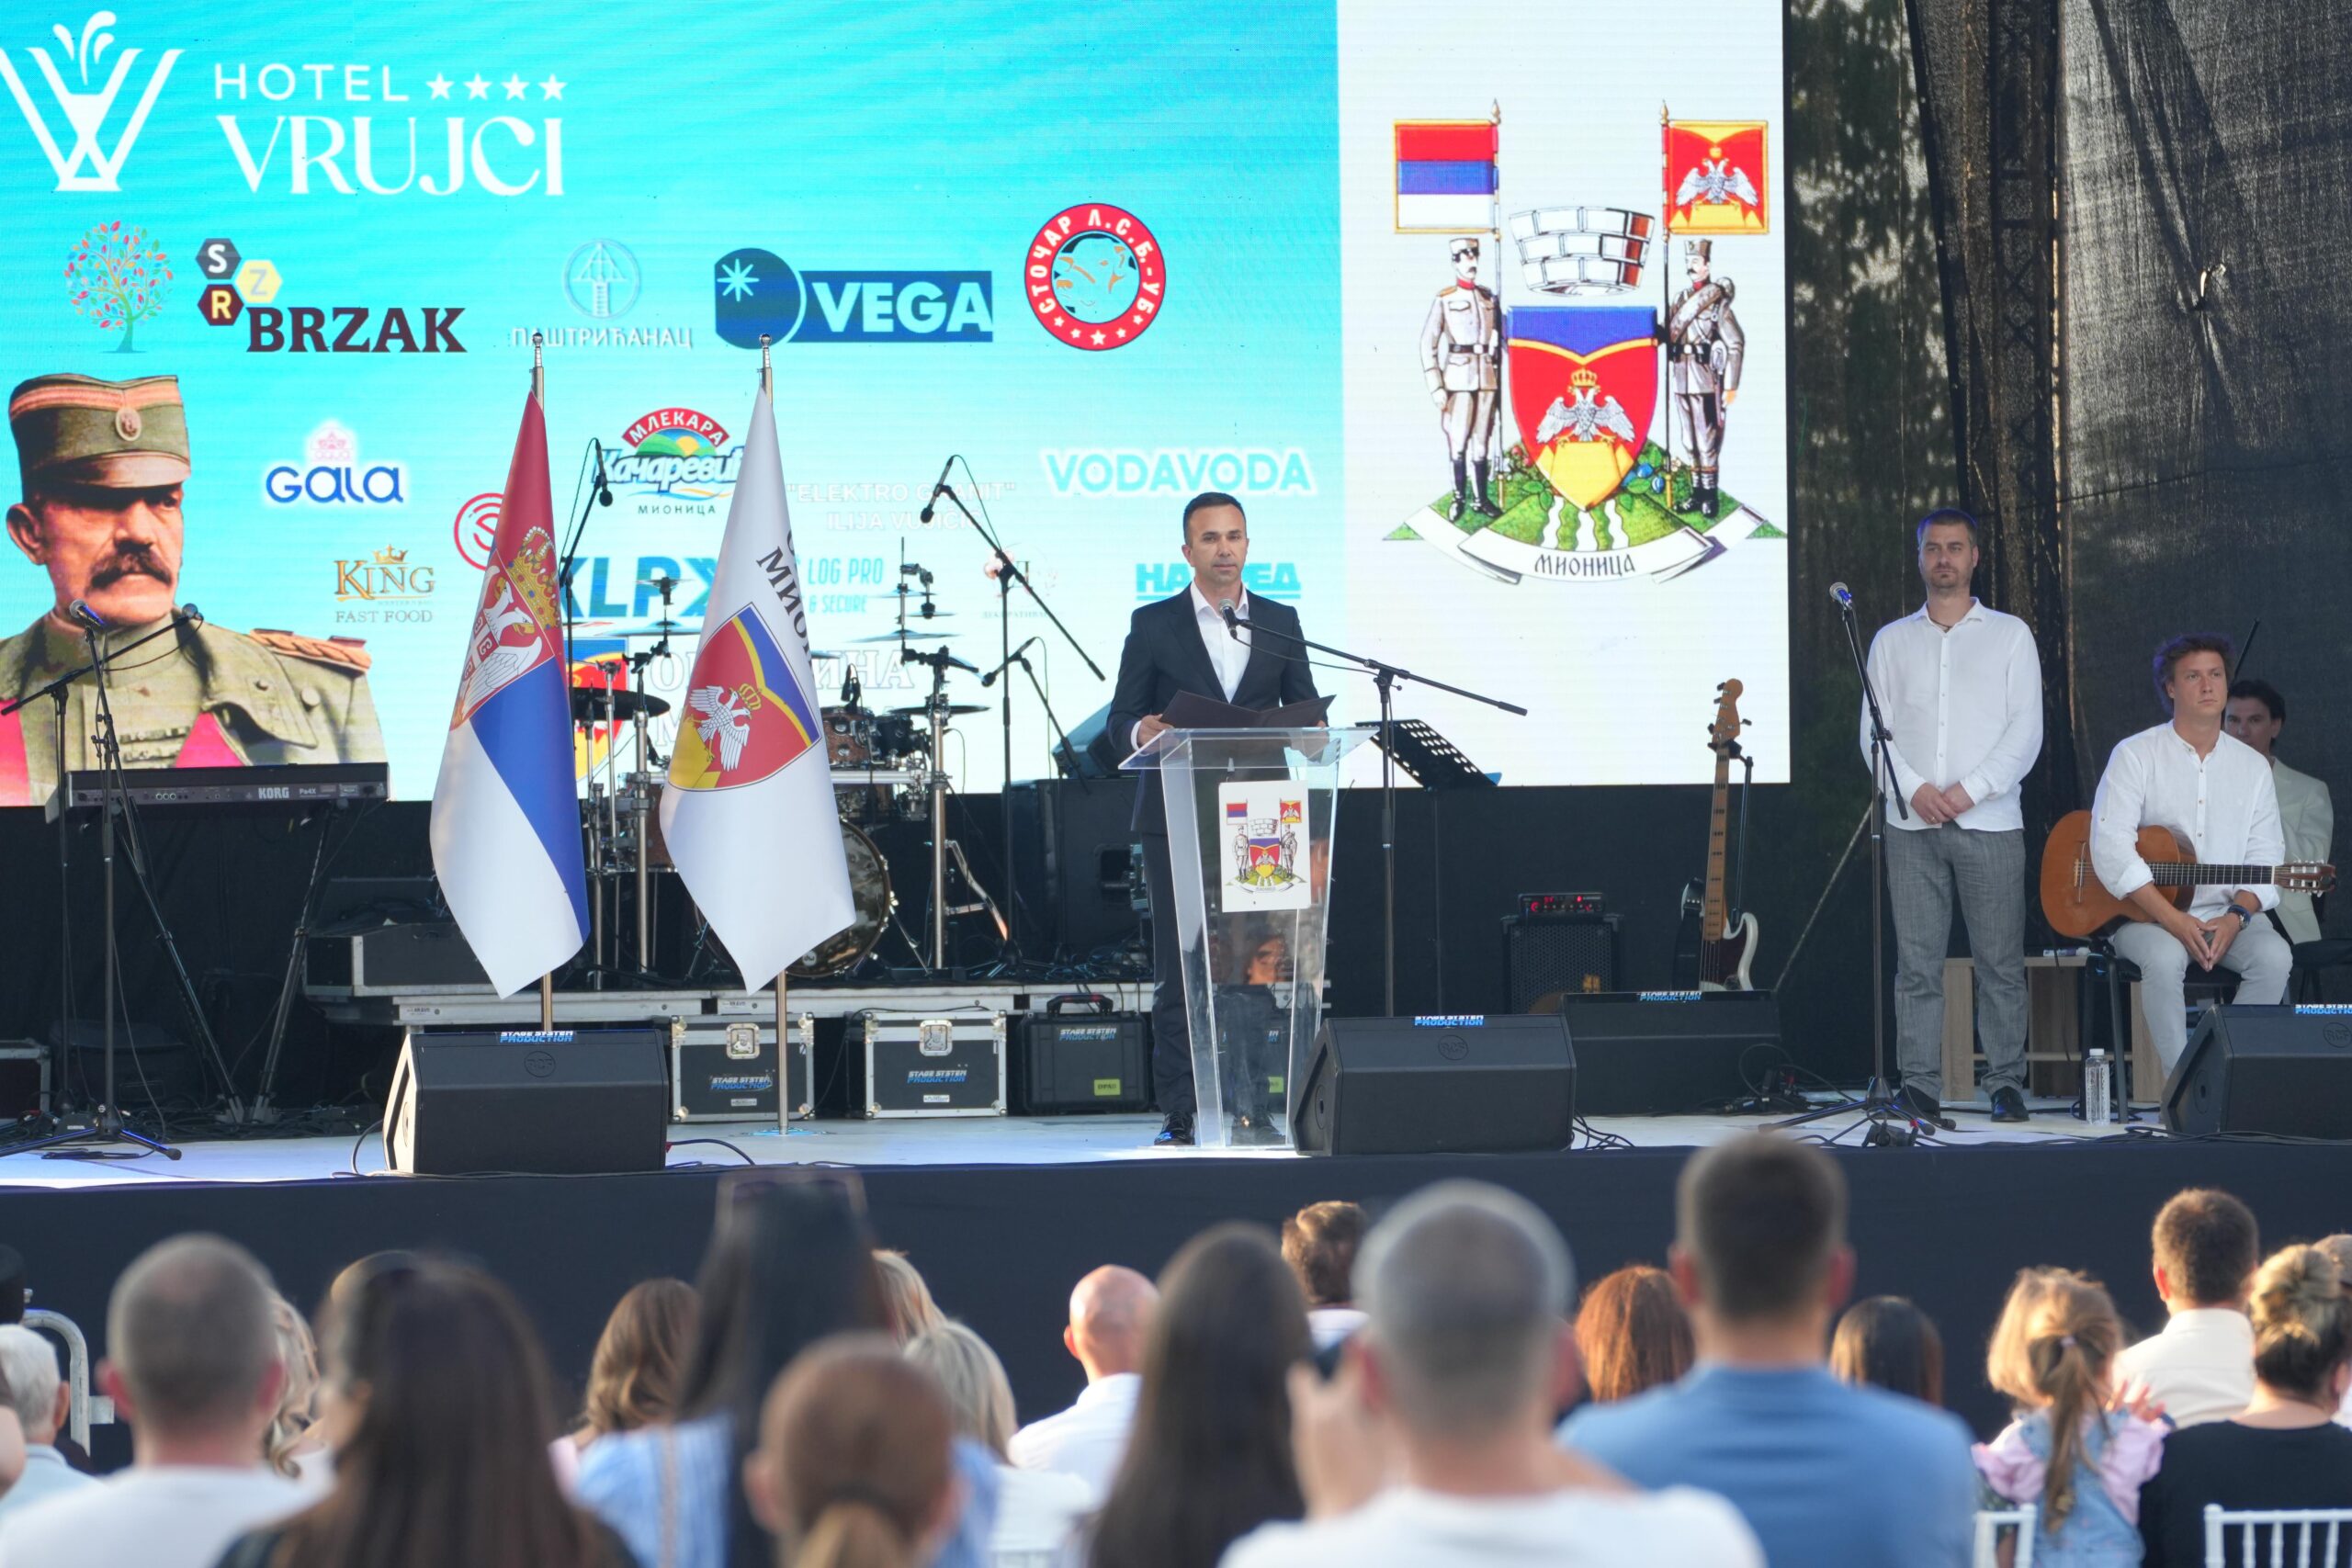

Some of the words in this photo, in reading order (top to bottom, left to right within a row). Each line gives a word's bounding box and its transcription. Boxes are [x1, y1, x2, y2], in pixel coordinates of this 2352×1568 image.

[214, 62, 410, 102] HOTEL
[216, 115, 564, 196] VRUJCI
[208, 243, 227, 274] S
[1029, 216, 1071, 314] СТОЧАР
[211, 290, 232, 319] R
[811, 281, 993, 333] VEGA
[246, 308, 468, 353] BRZAK
[628, 411, 724, 446] МЛЕКАРА
[1045, 453, 1311, 492] VODAVODA
[638, 504, 717, 516] МИОНИЦА
[334, 559, 435, 600] KING
[808, 558, 841, 585] LOG
[848, 558, 884, 585] PRO
[1533, 553, 1636, 578] МИОНИЦА
[335, 610, 379, 623] FAST
[384, 609, 433, 623] FOOD
[258, 787, 289, 799] KORG
[500, 1035, 573, 1043] PRODUCTION
